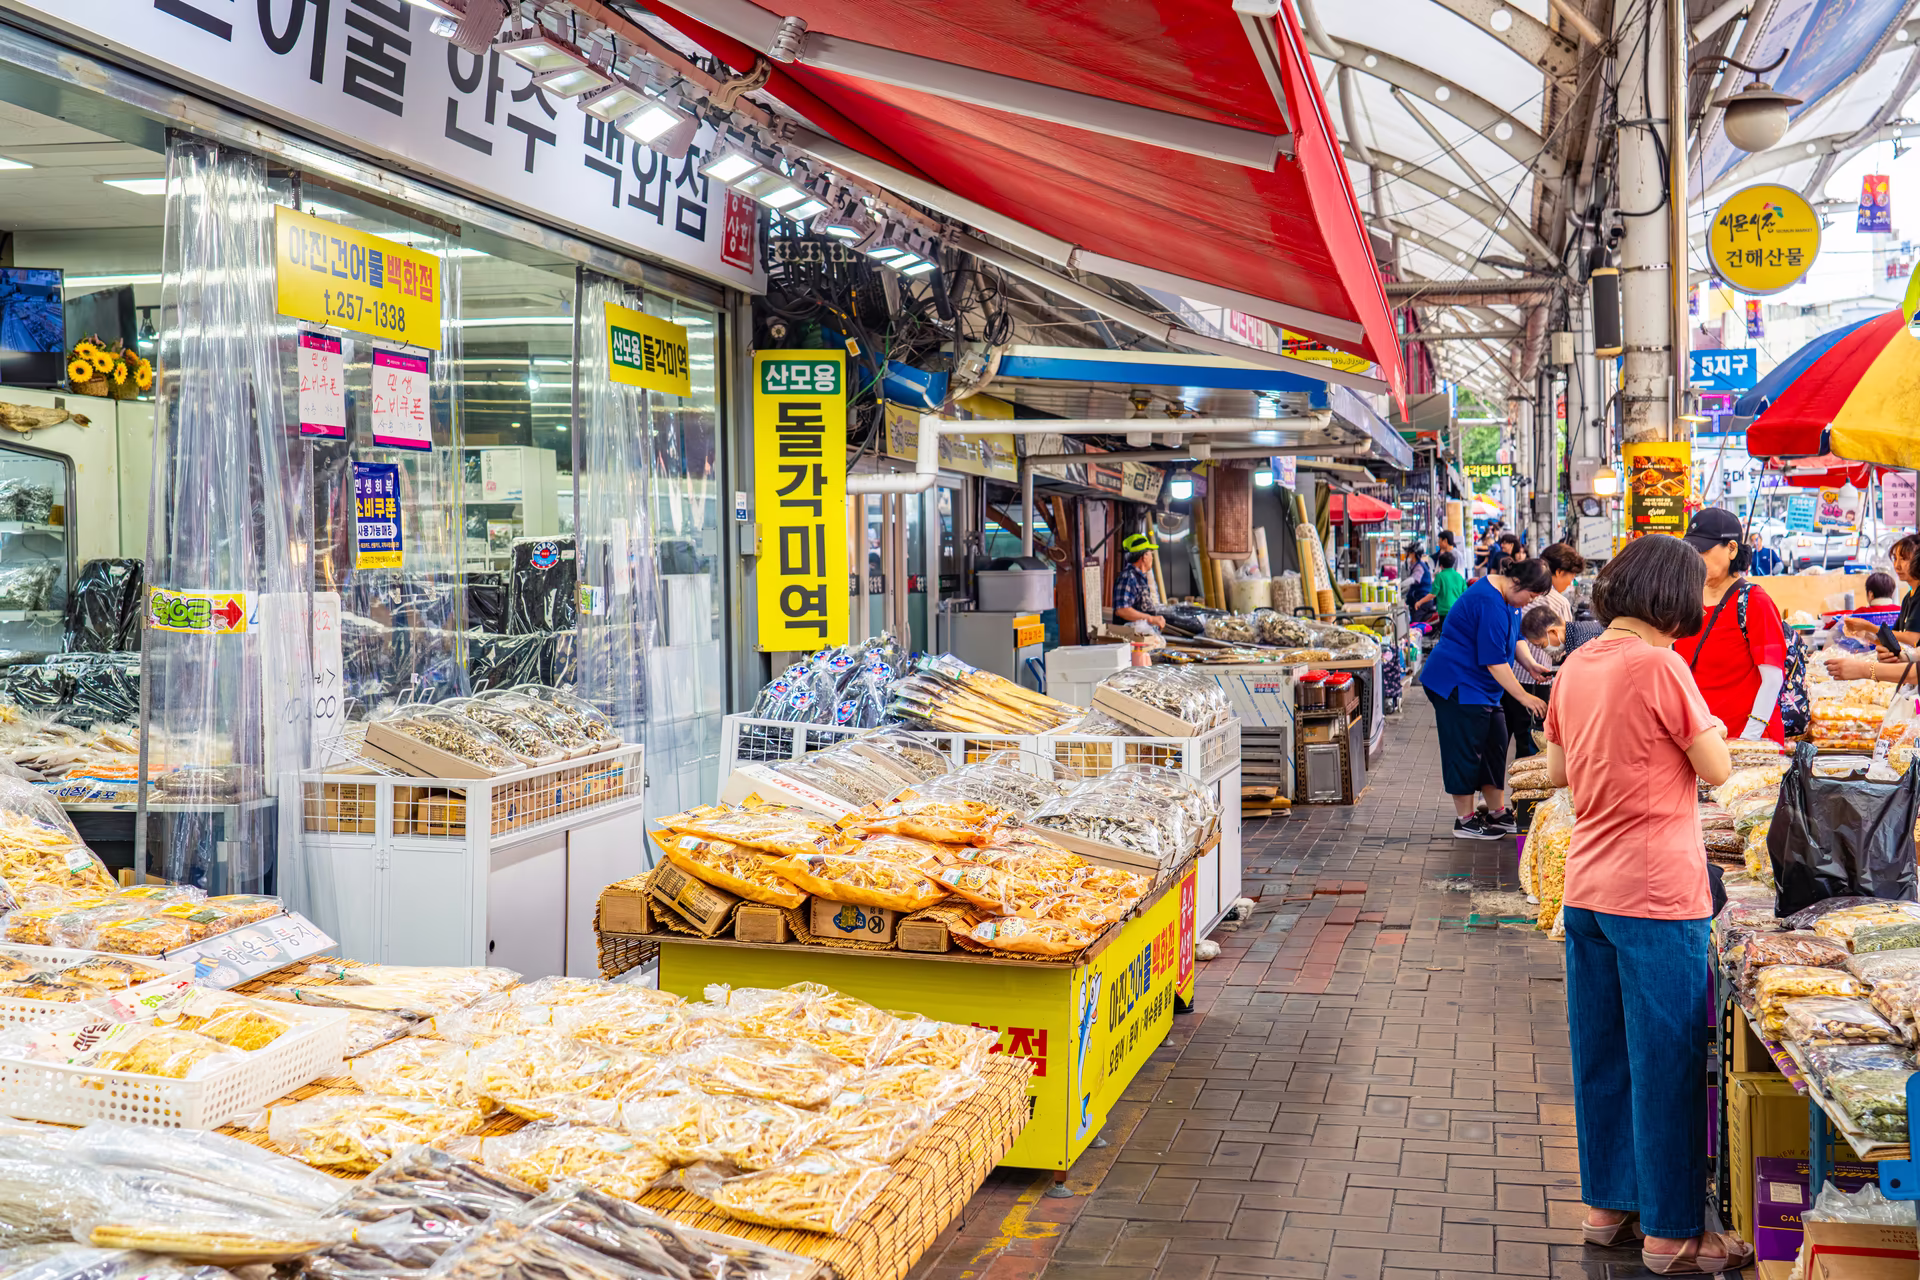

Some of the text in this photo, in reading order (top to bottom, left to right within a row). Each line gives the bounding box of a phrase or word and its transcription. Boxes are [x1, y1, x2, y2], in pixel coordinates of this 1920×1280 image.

[1719, 212, 1776, 242] 서문시장
[1725, 247, 1805, 268] 건해산물
[324, 289, 406, 332] t.257-1338
[613, 331, 688, 380] 산모용 돌각미역
[1701, 354, 1749, 377] 5지구
[765, 363, 836, 392] 산모용
[355, 497, 397, 519] 소비쿠폰
[774, 402, 829, 638] 돌각미역
[221, 921, 319, 967] 한옥누룽지
